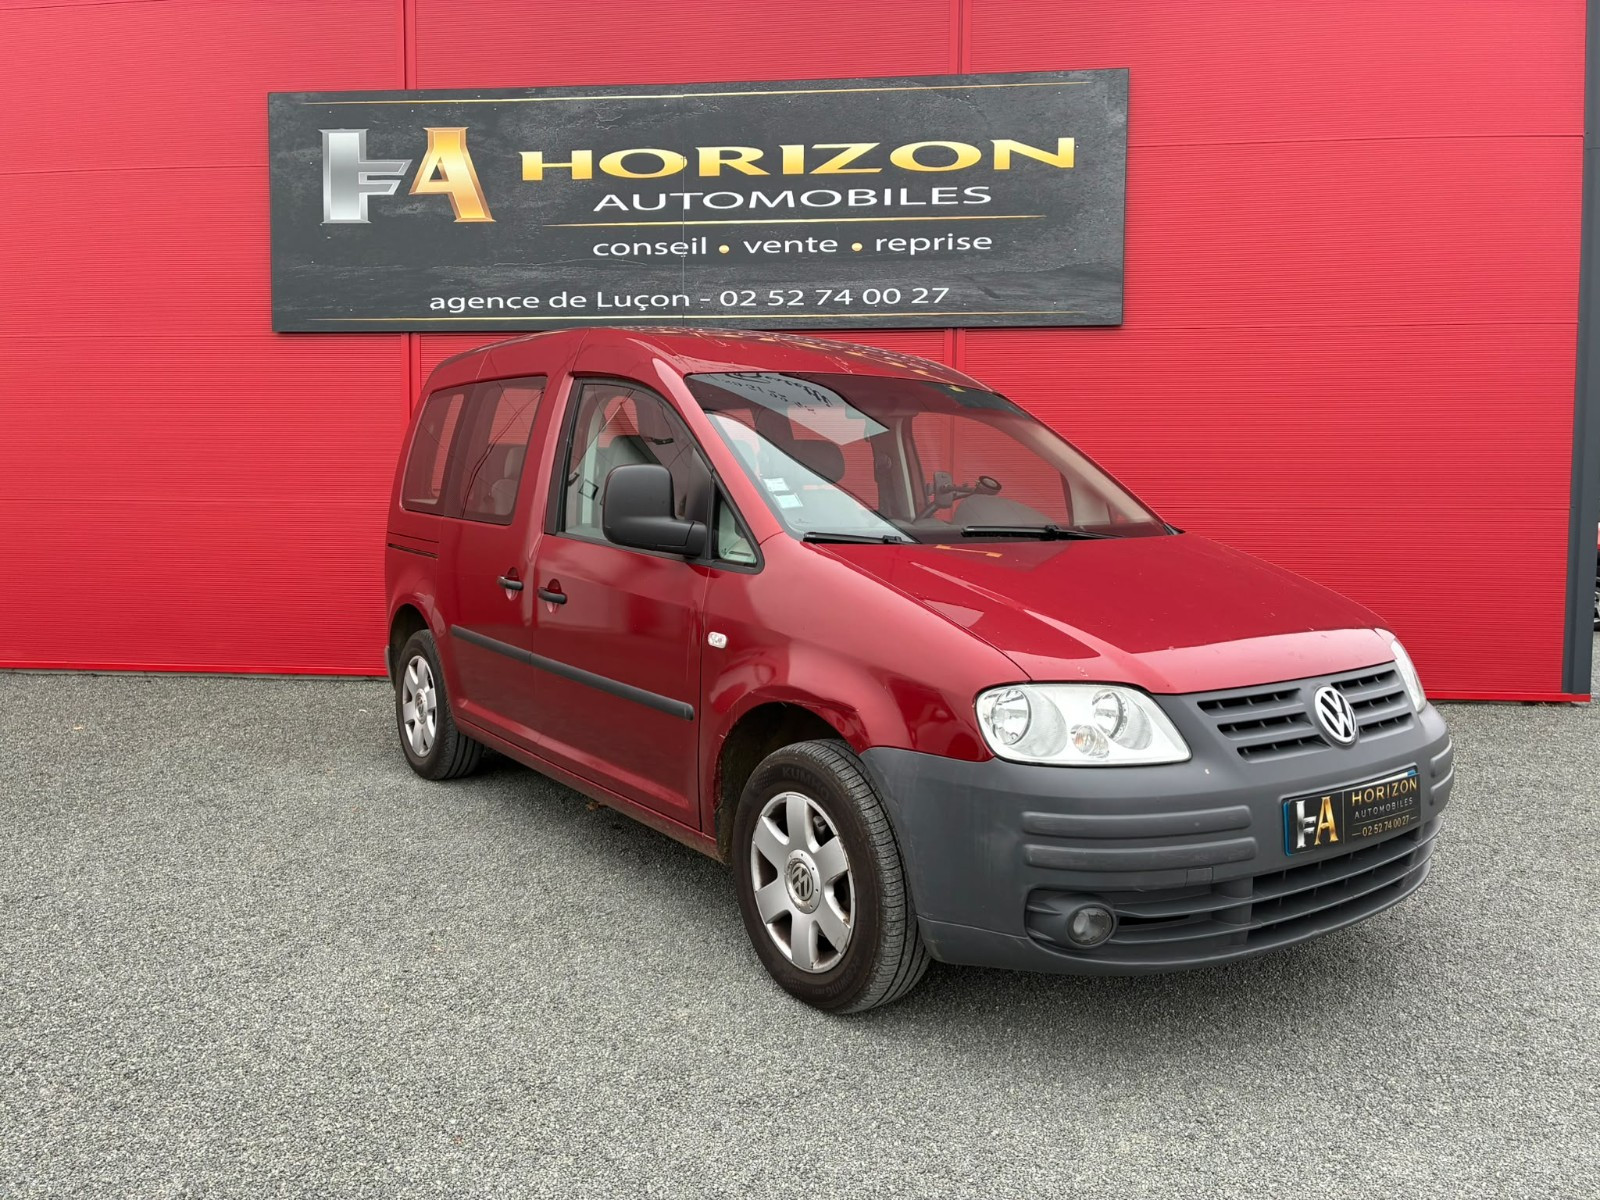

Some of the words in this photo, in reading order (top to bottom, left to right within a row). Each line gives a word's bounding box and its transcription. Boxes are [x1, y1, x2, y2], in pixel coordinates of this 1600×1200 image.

[519, 137, 1075, 181] HORIZON
[593, 186, 992, 212] AUTOMOBILES
[593, 236, 707, 257] conseil
[743, 236, 838, 254] vente
[876, 233, 993, 256] reprise
[429, 296, 540, 313] agence
[549, 291, 587, 309] de
[597, 291, 690, 311] Luçon
[719, 290, 757, 307] 02
[767, 289, 805, 306] 52
[815, 289, 854, 306] 74
[862, 287, 902, 305] 00
[911, 287, 950, 304] 27
[1351, 777, 1418, 806] HORIZON
[1354, 797, 1414, 819] AUTOMOBILES
[1362, 825, 1373, 837] 02
[1373, 822, 1383, 834] 52
